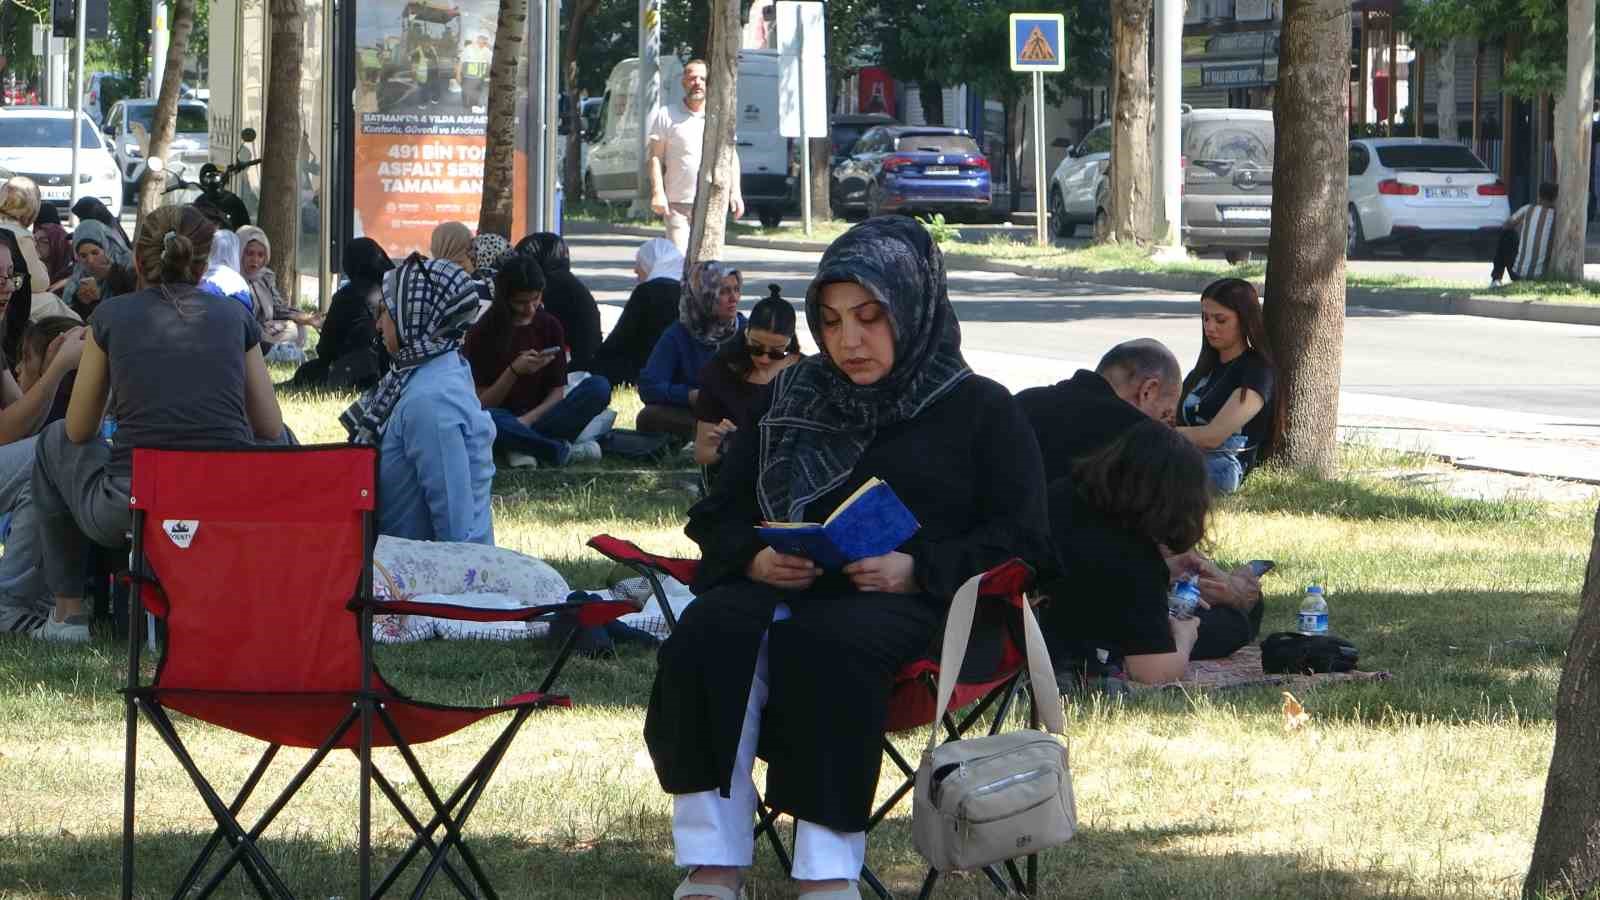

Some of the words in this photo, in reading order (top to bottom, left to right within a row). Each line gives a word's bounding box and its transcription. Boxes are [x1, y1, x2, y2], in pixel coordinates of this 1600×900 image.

[420, 115, 427, 123] 4
[388, 144, 418, 159] 491
[422, 140, 453, 160] BİN
[377, 161, 445, 176] ASFALT
[381, 178, 483, 193] TAMAMLAN
